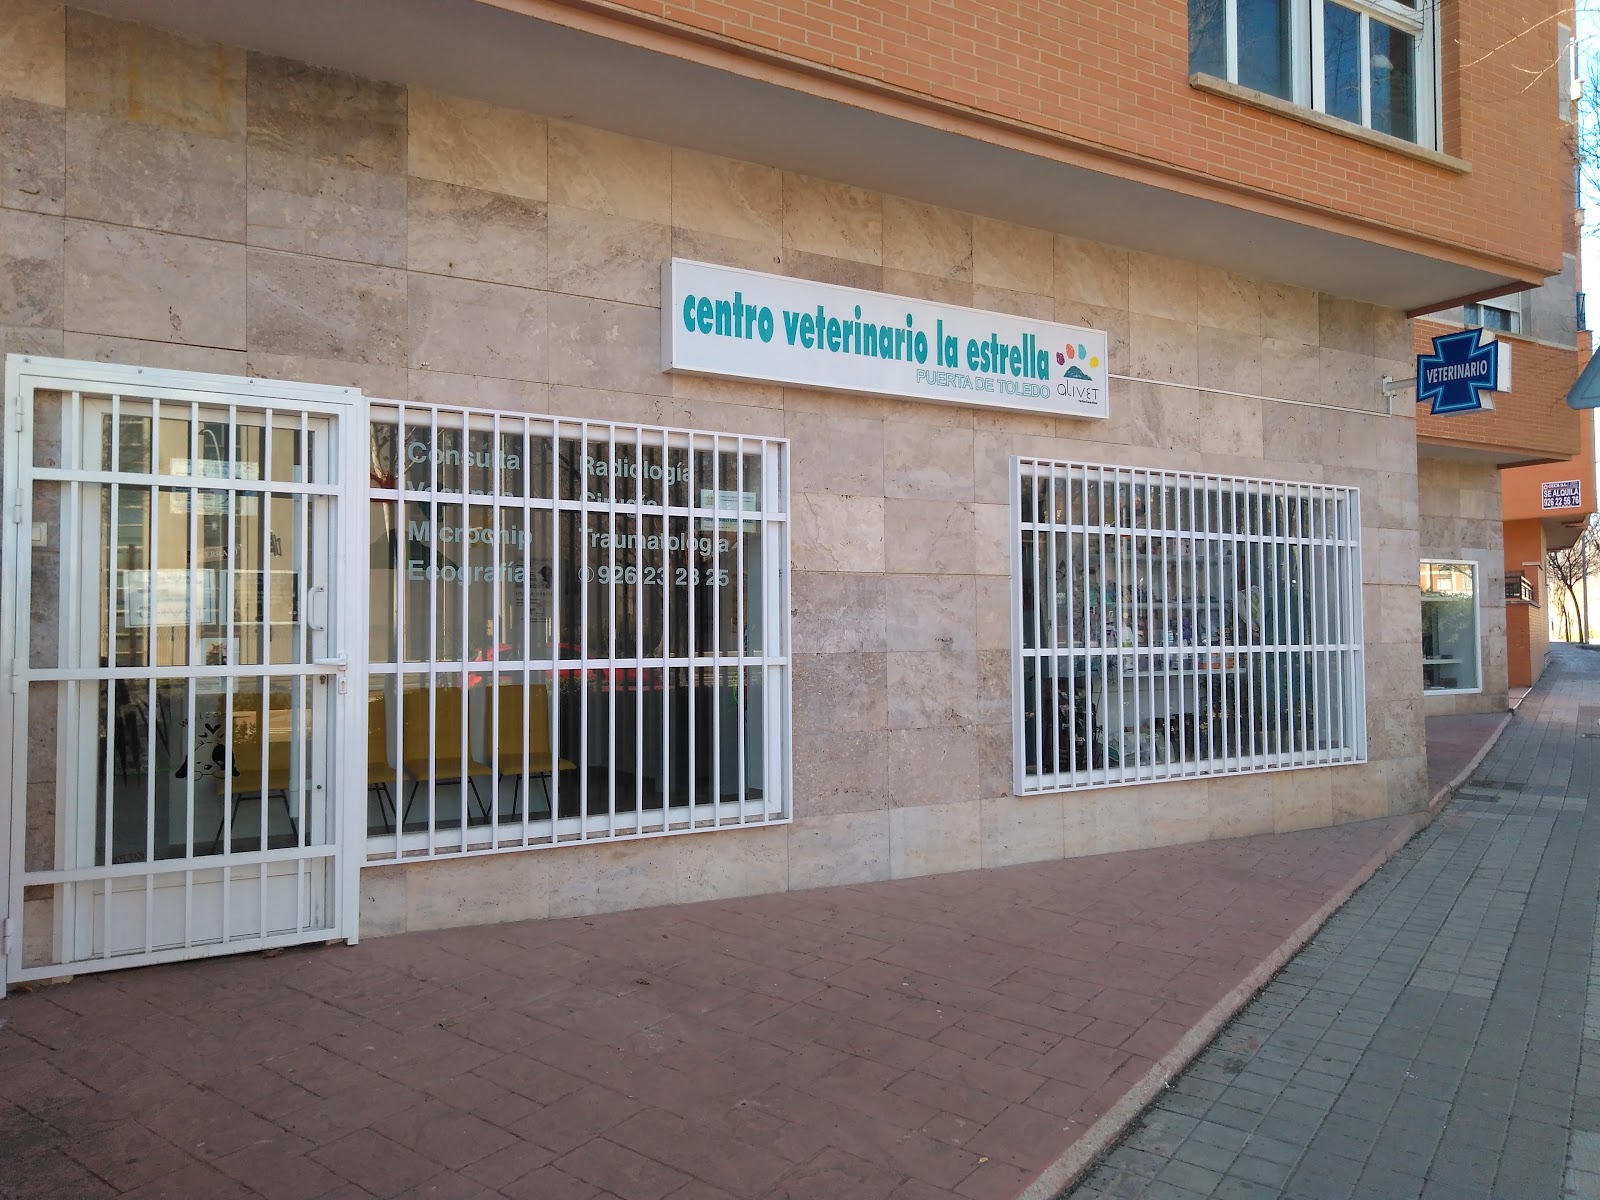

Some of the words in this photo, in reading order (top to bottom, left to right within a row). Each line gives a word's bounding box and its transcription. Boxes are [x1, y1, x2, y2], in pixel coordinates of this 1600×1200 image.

[683, 291, 774, 343] centro
[782, 305, 928, 364] veterinario
[936, 319, 959, 368] la
[966, 333, 1049, 381] estrella
[916, 368, 973, 390] PUERTA
[975, 377, 995, 393] DE
[997, 379, 1050, 399] TOLEDO
[1426, 359, 1488, 384] VETERINARIO
[1543, 490, 1552, 498] SE
[1552, 488, 1579, 497] ALQUILA
[408, 520, 533, 551] Mcrochip
[578, 527, 730, 557] Traumatologa
[597, 565, 637, 585] 926
[705, 568, 730, 587] 25
